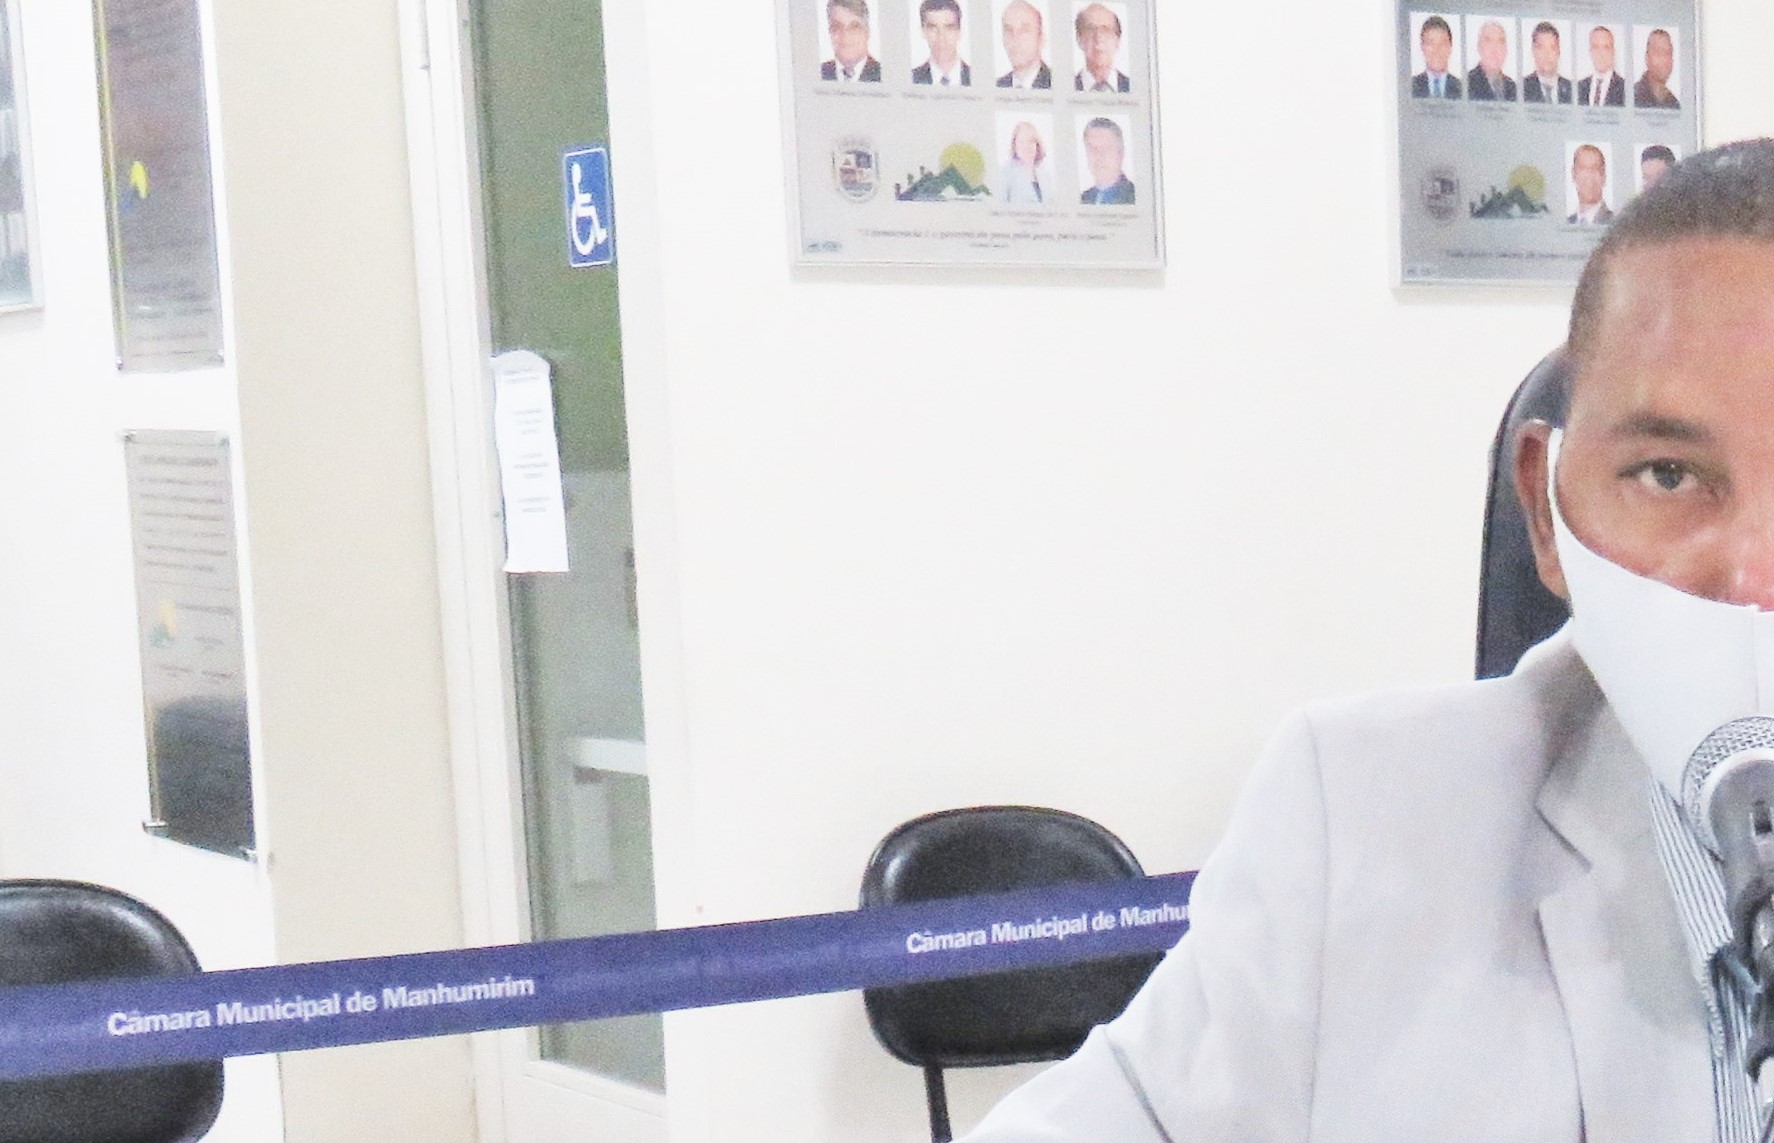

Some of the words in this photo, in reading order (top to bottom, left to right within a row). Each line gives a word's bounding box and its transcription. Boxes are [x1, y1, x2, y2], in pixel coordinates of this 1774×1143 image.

[906, 929, 986, 954] Câmara
[991, 914, 1087, 940] Municipal
[1091, 911, 1116, 931] de
[1120, 903, 1190, 927] Manhu
[107, 1008, 211, 1037] Câmara
[216, 993, 341, 1026] Municipal
[346, 990, 377, 1014] de
[383, 975, 535, 1009] Manhumirim
